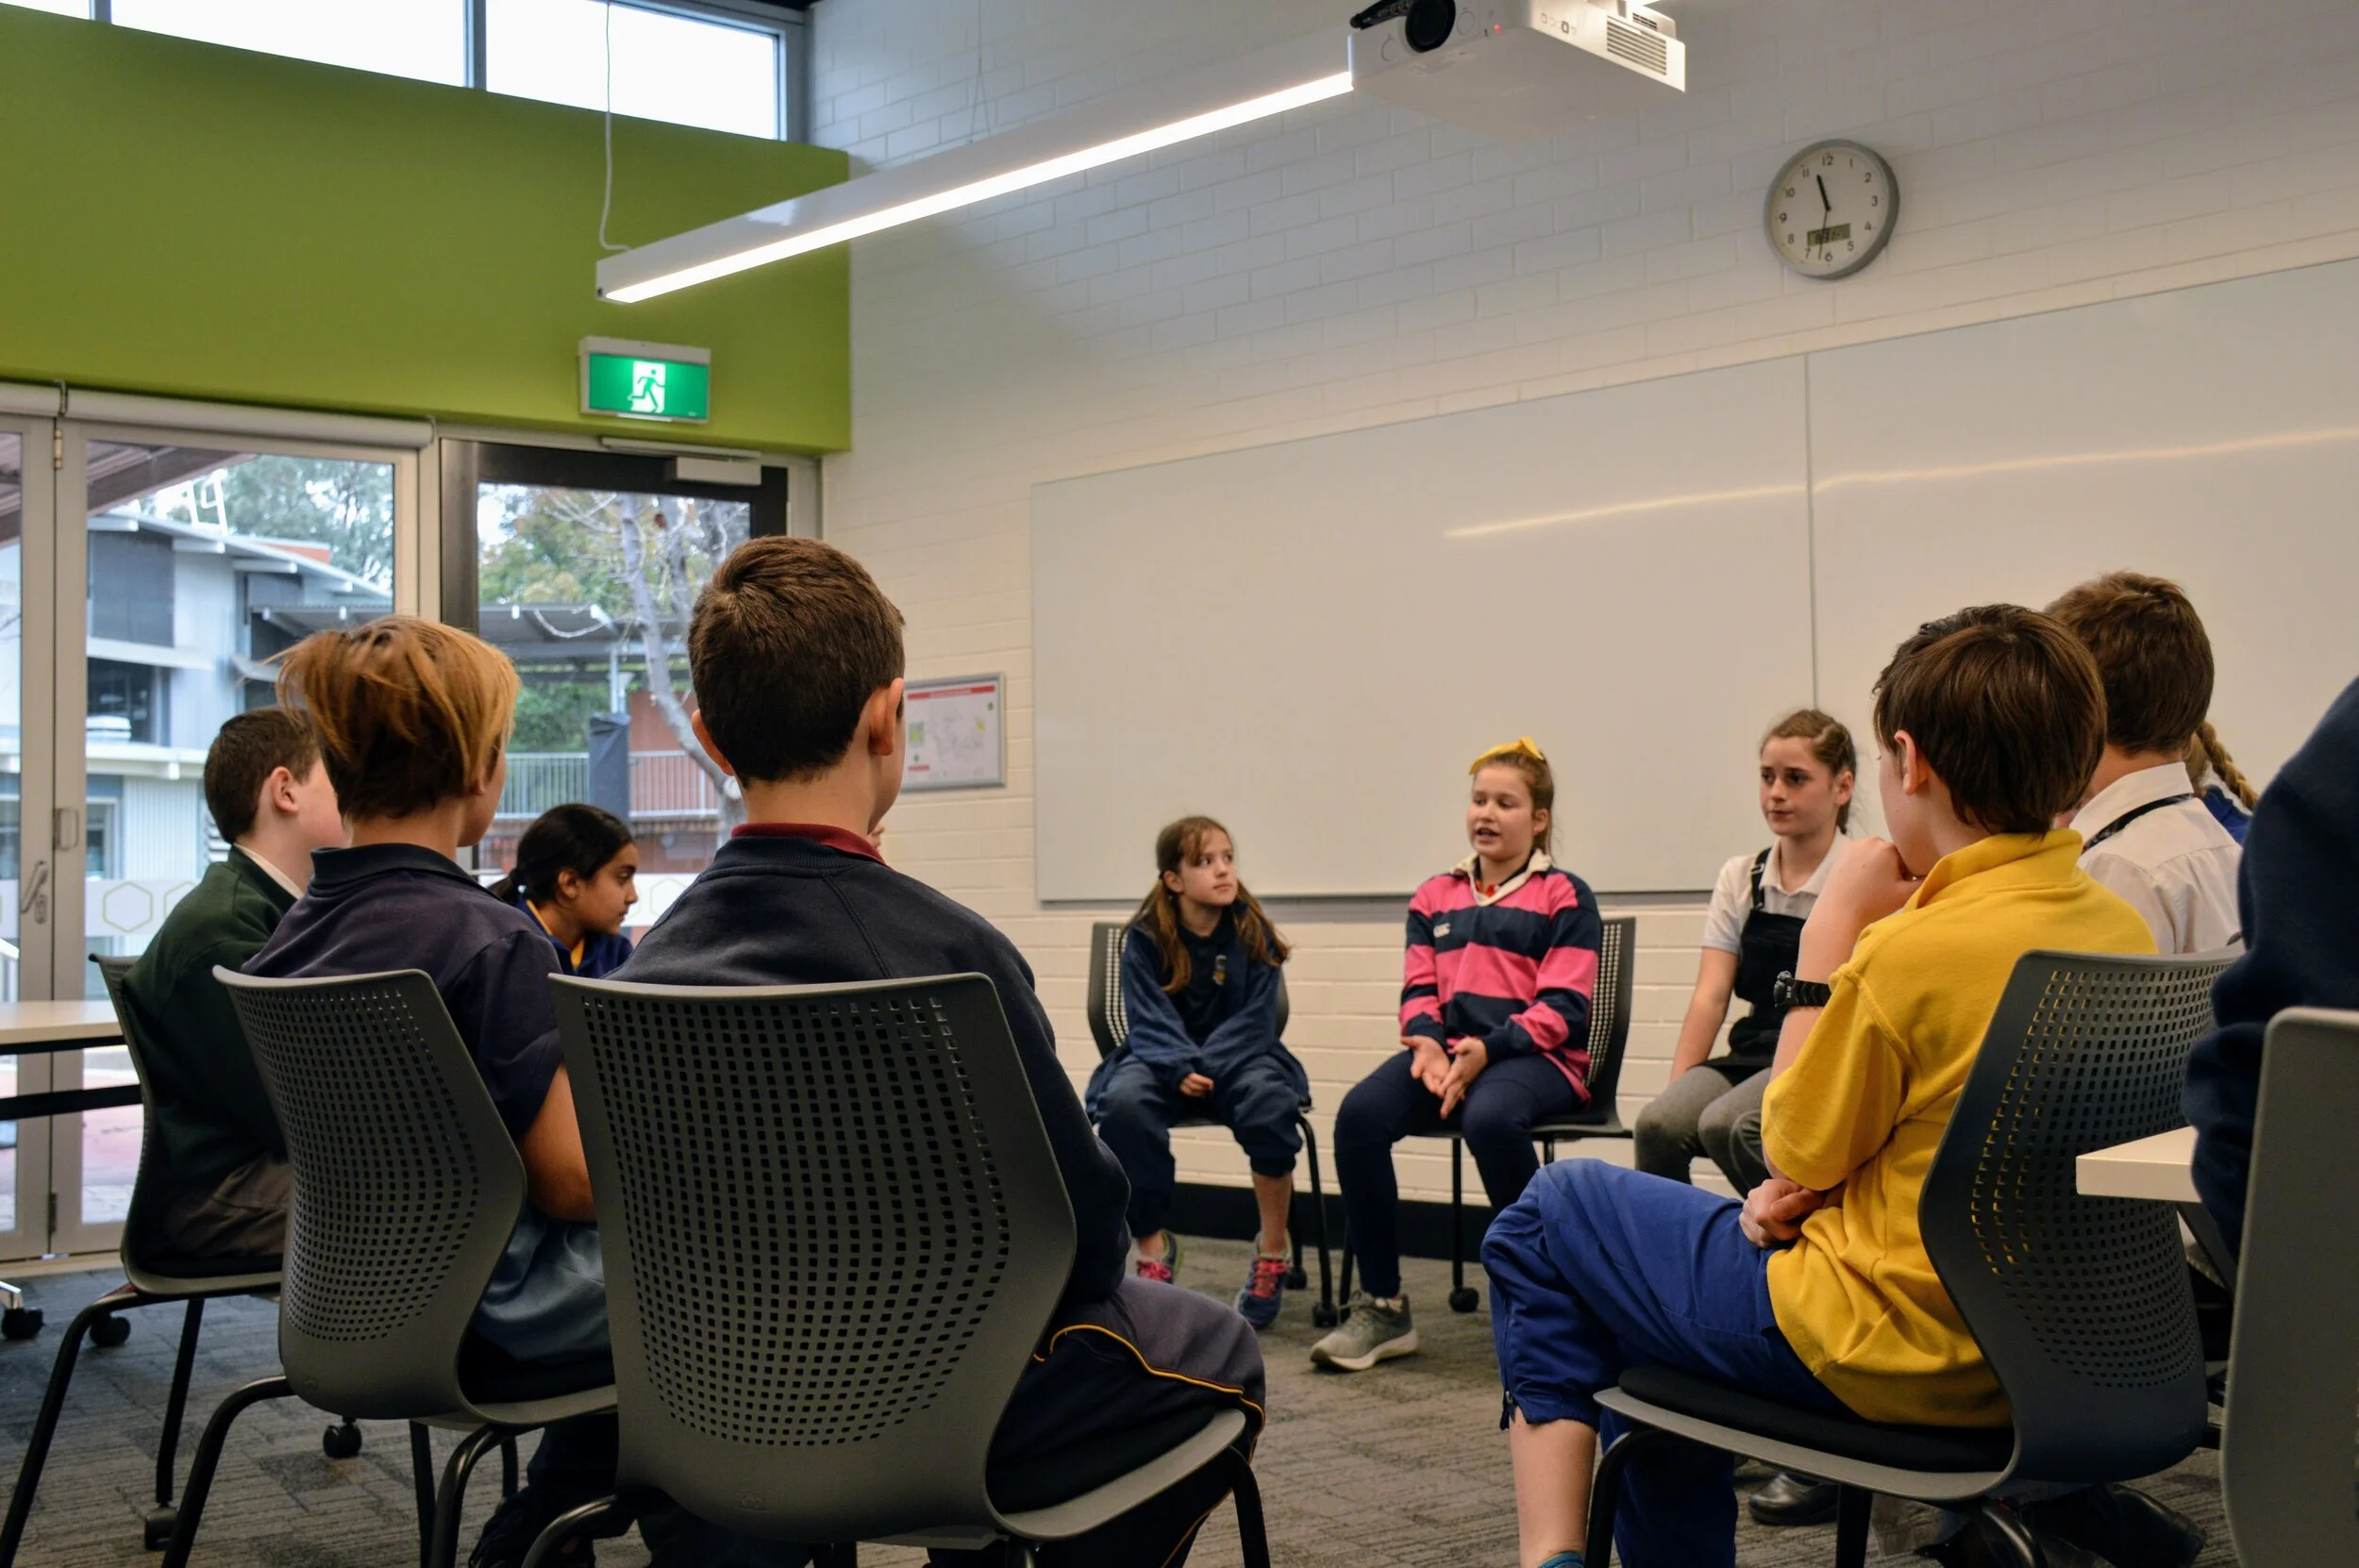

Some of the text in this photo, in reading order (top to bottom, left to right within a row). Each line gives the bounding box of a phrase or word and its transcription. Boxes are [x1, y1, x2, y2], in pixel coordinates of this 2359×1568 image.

[1822, 155, 1833, 166] 12
[1802, 168, 1809, 178] 11
[1865, 173, 1871, 183] 2
[1785, 188, 1795, 198] 10
[1872, 196, 1878, 206] 3
[1780, 212, 1787, 223] 9
[1865, 221, 1871, 231] 4
[1788, 234, 1794, 244] 8
[1848, 241, 1854, 250] 5
[1805, 248, 1811, 259] 7
[1825, 251, 1832, 262] 6
